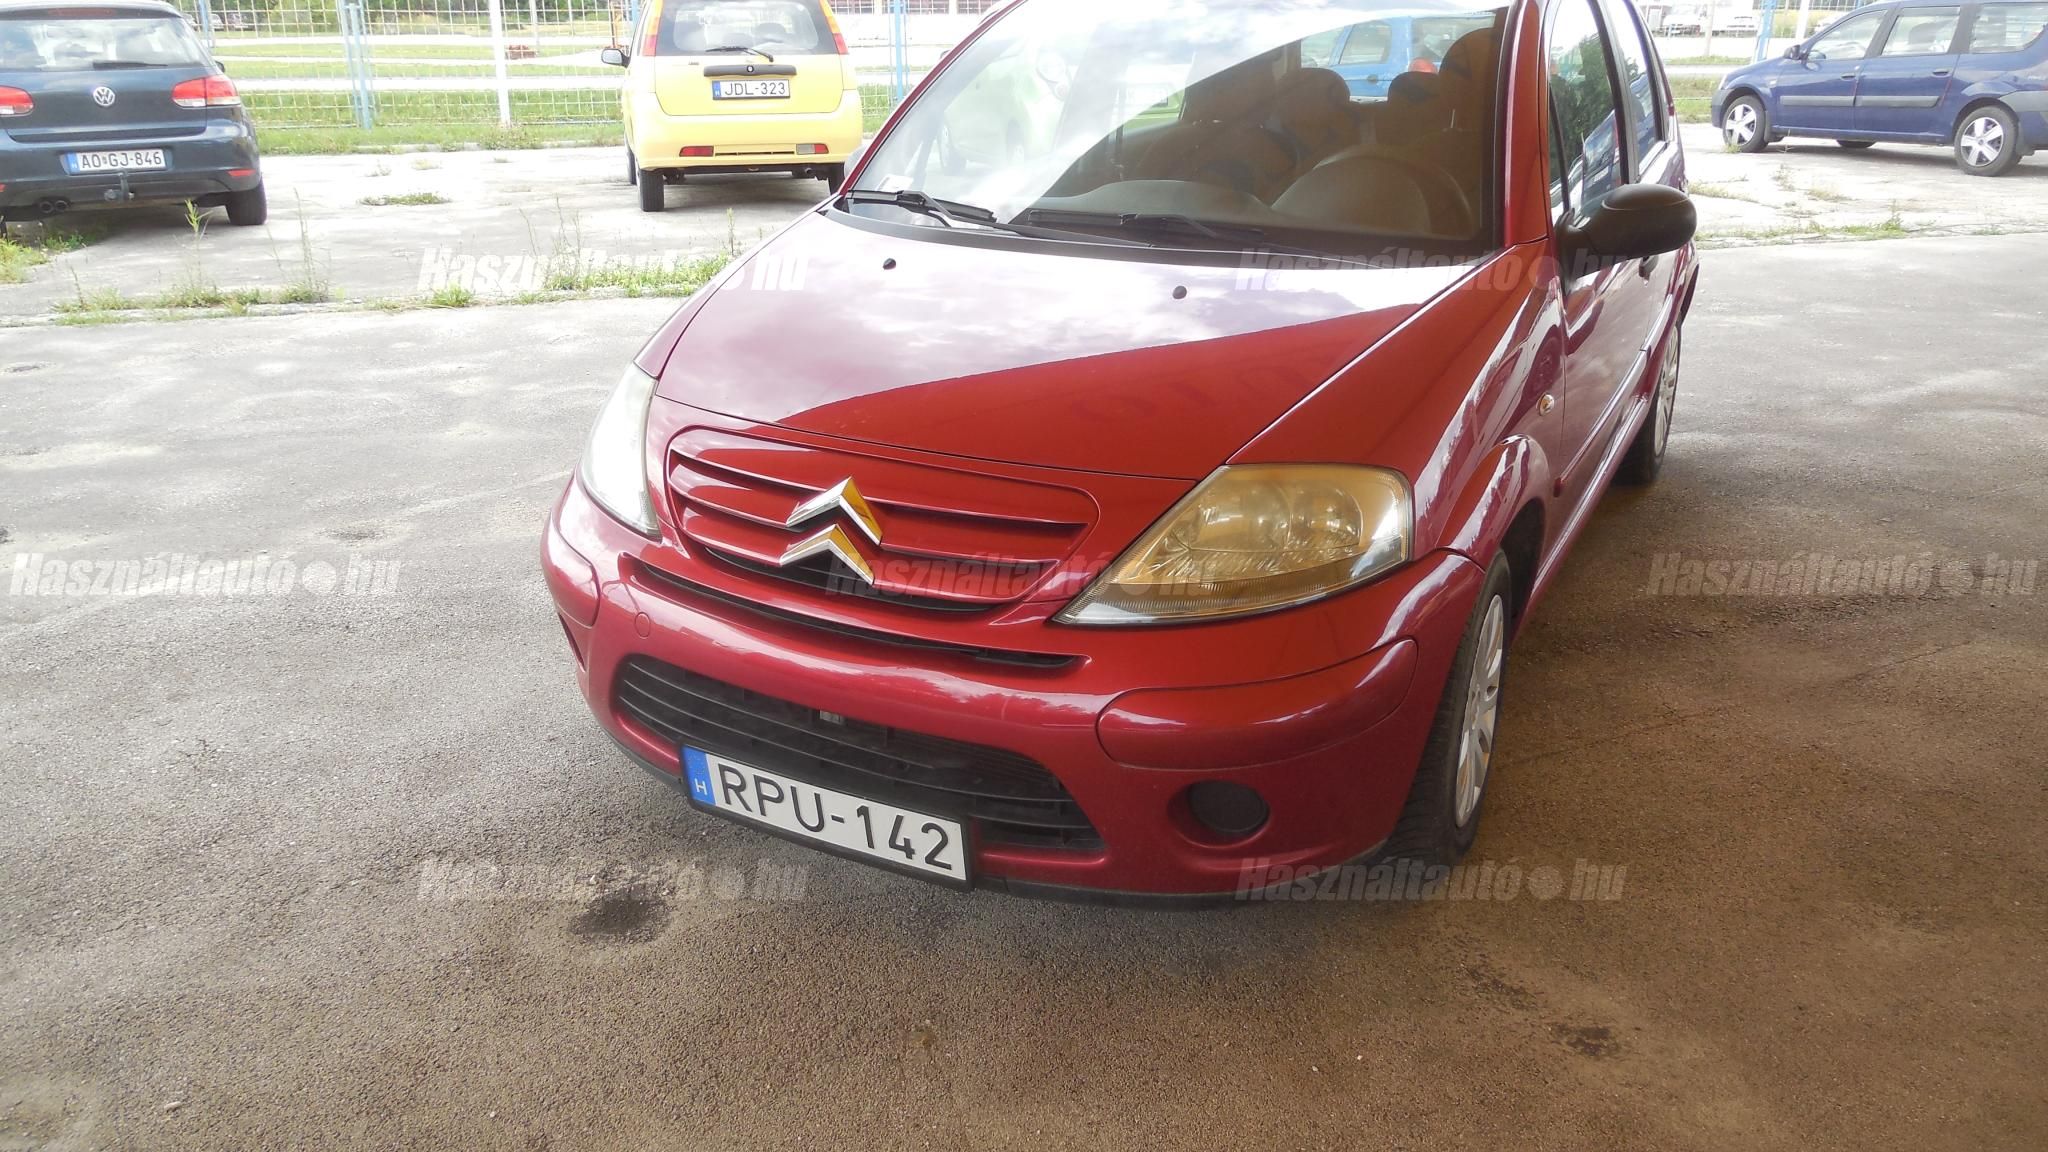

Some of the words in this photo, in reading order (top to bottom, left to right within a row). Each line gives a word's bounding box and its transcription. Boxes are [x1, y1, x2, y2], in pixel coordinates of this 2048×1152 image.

[725, 82, 786, 96] JDL-323
[695, 777, 708, 796] H
[717, 763, 953, 871] RPU-142
